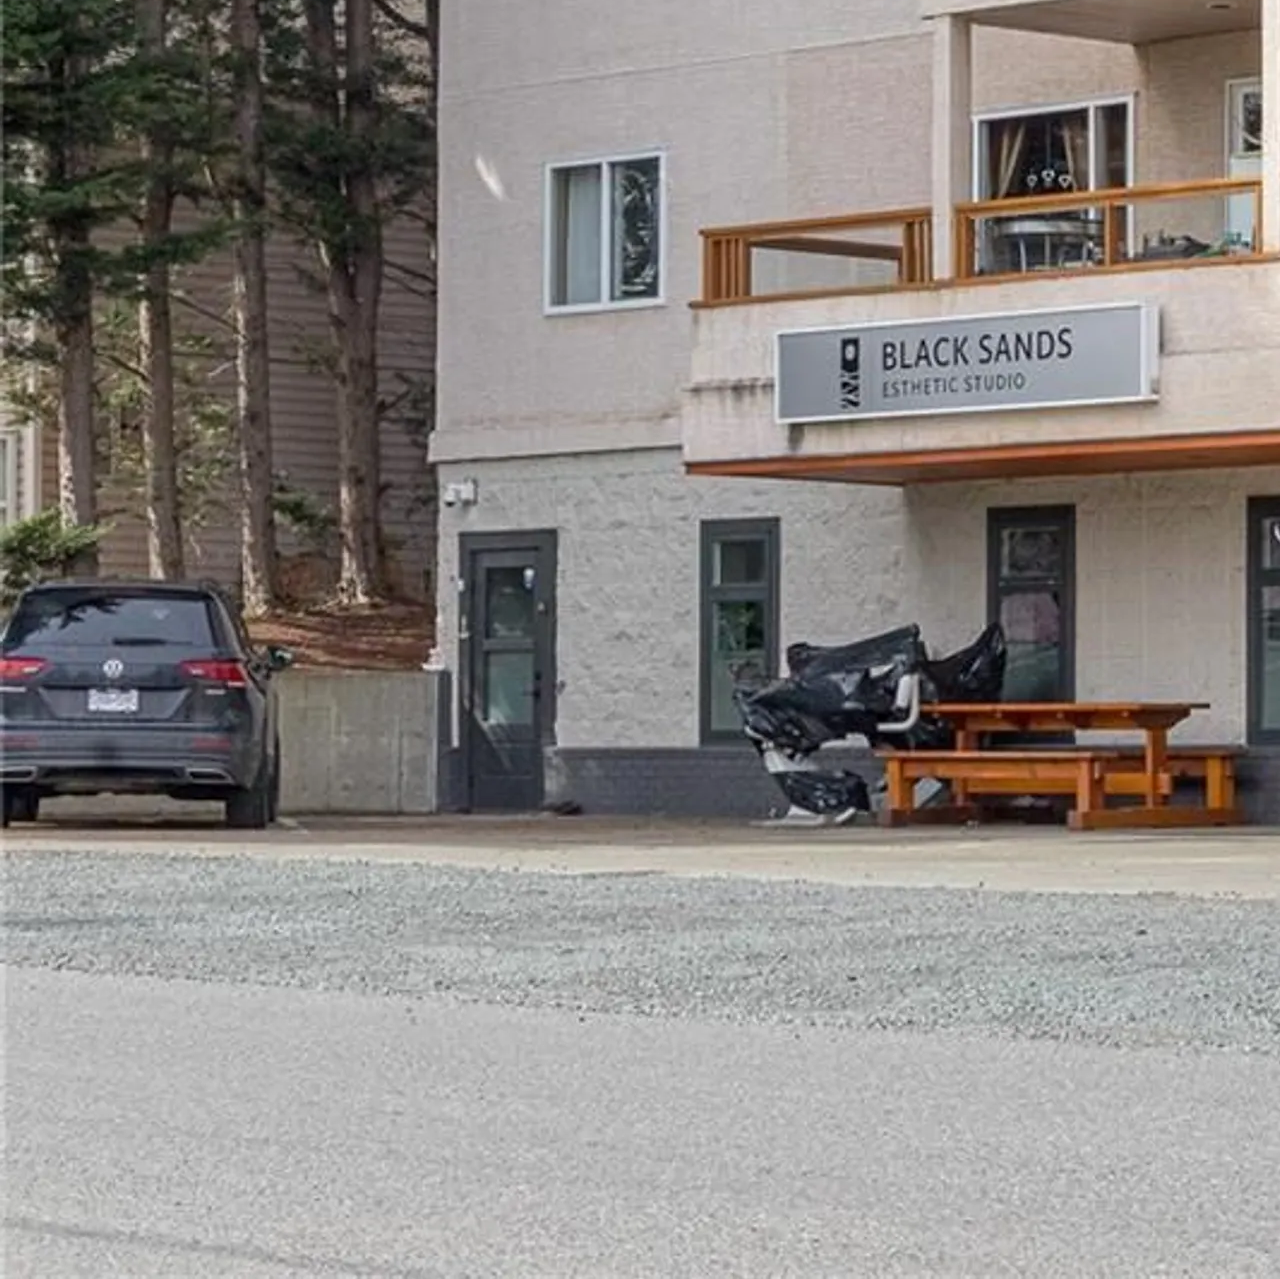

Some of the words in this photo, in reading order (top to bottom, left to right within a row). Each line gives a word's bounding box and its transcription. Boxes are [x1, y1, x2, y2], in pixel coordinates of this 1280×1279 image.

[882, 336, 969, 371] BLACK
[978, 327, 1073, 364] SANDS
[883, 377, 958, 398] ESTHETIC
[963, 372, 1026, 392] STUDIO
